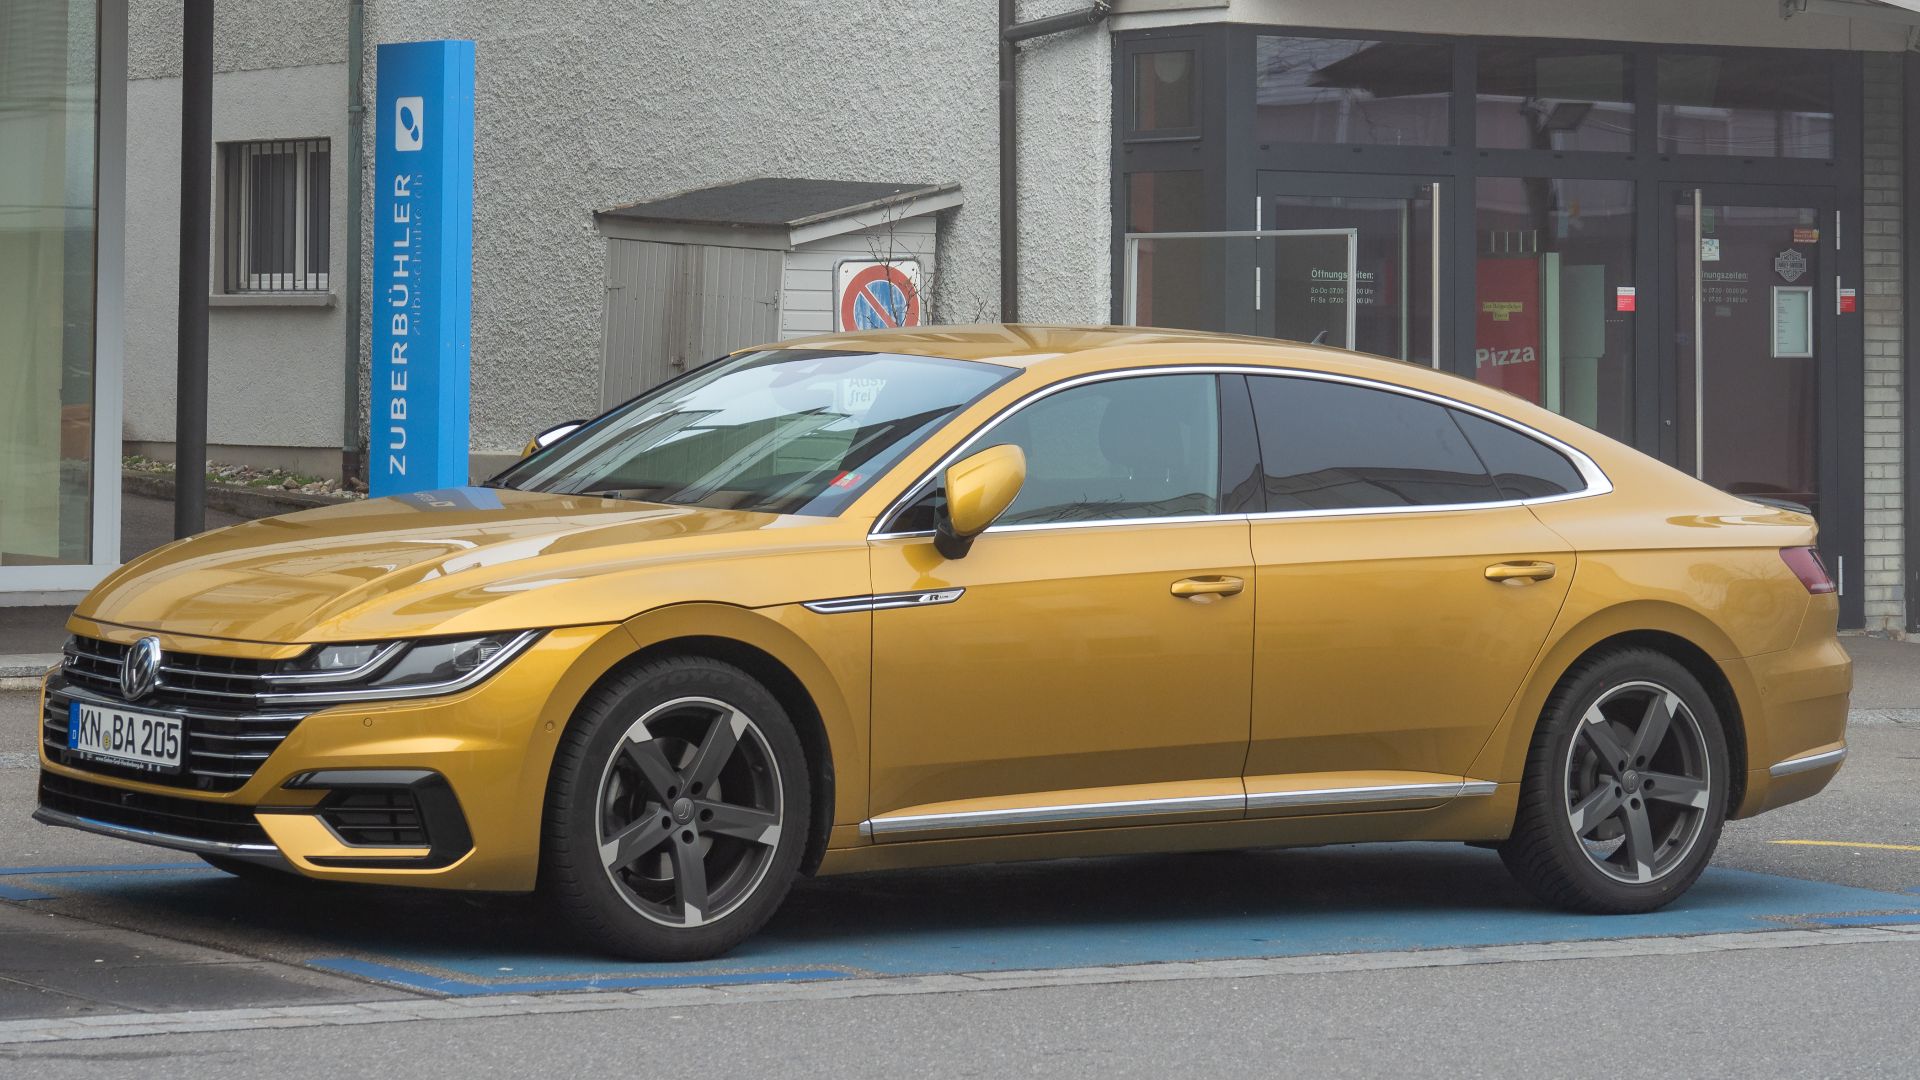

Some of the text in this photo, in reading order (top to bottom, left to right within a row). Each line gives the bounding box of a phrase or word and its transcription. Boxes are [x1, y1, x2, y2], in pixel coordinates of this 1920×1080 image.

[1311, 268, 1374, 280] Öffnungsiten:
[388, 174, 411, 476] ZUBERBÜHLER
[1475, 346, 1535, 368] Pizza
[80, 708, 102, 748] KN
[112, 714, 136, 754] BA
[141, 719, 180, 760] 205
